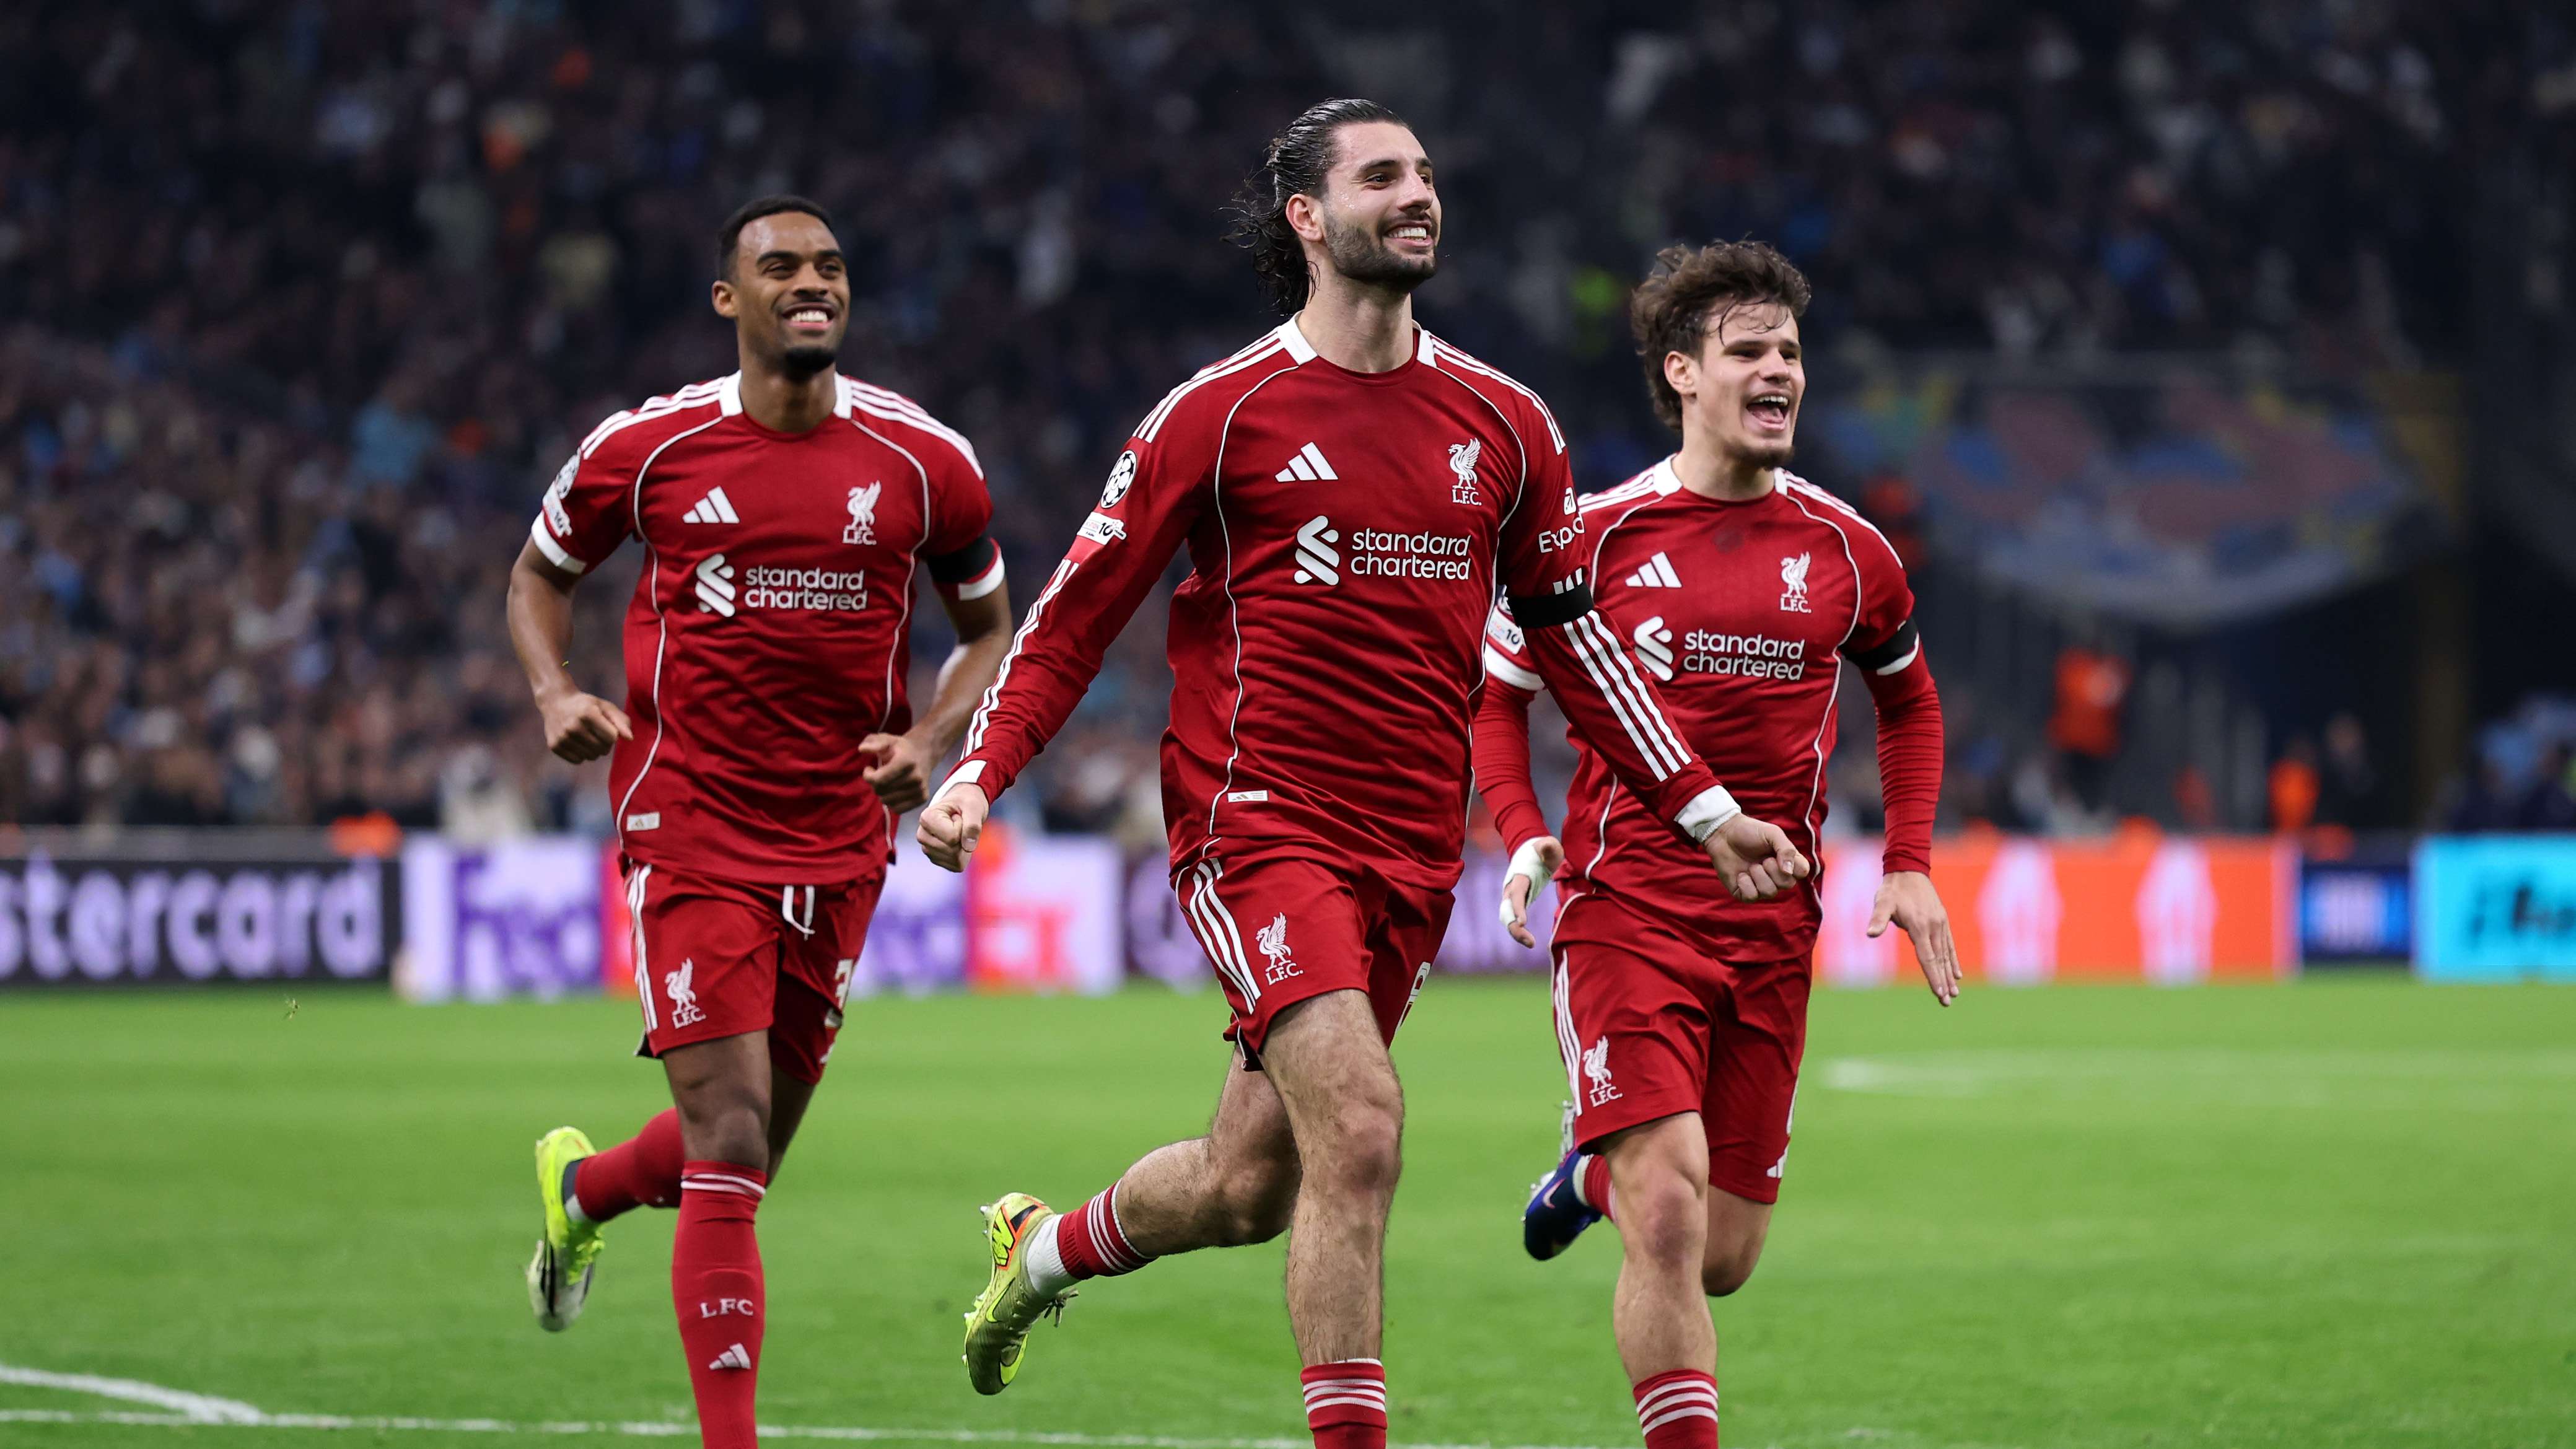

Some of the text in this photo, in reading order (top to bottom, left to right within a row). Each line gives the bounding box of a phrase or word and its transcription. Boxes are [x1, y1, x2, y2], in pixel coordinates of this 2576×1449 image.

[1452, 489, 1482, 506] L.F.C.
[1352, 528, 1471, 556] standard
[745, 564, 864, 589] standard
[1351, 552, 1471, 580] chartered
[745, 587, 867, 610] chartered
[1780, 597, 1812, 613] L.F.C.
[1684, 629, 1805, 660] standard
[1683, 652, 1805, 680] chartered
[1265, 961, 1303, 986] L.F.C.
[1590, 1086, 1623, 1108] L.F.C.
[700, 1298, 753, 1318] LFC
